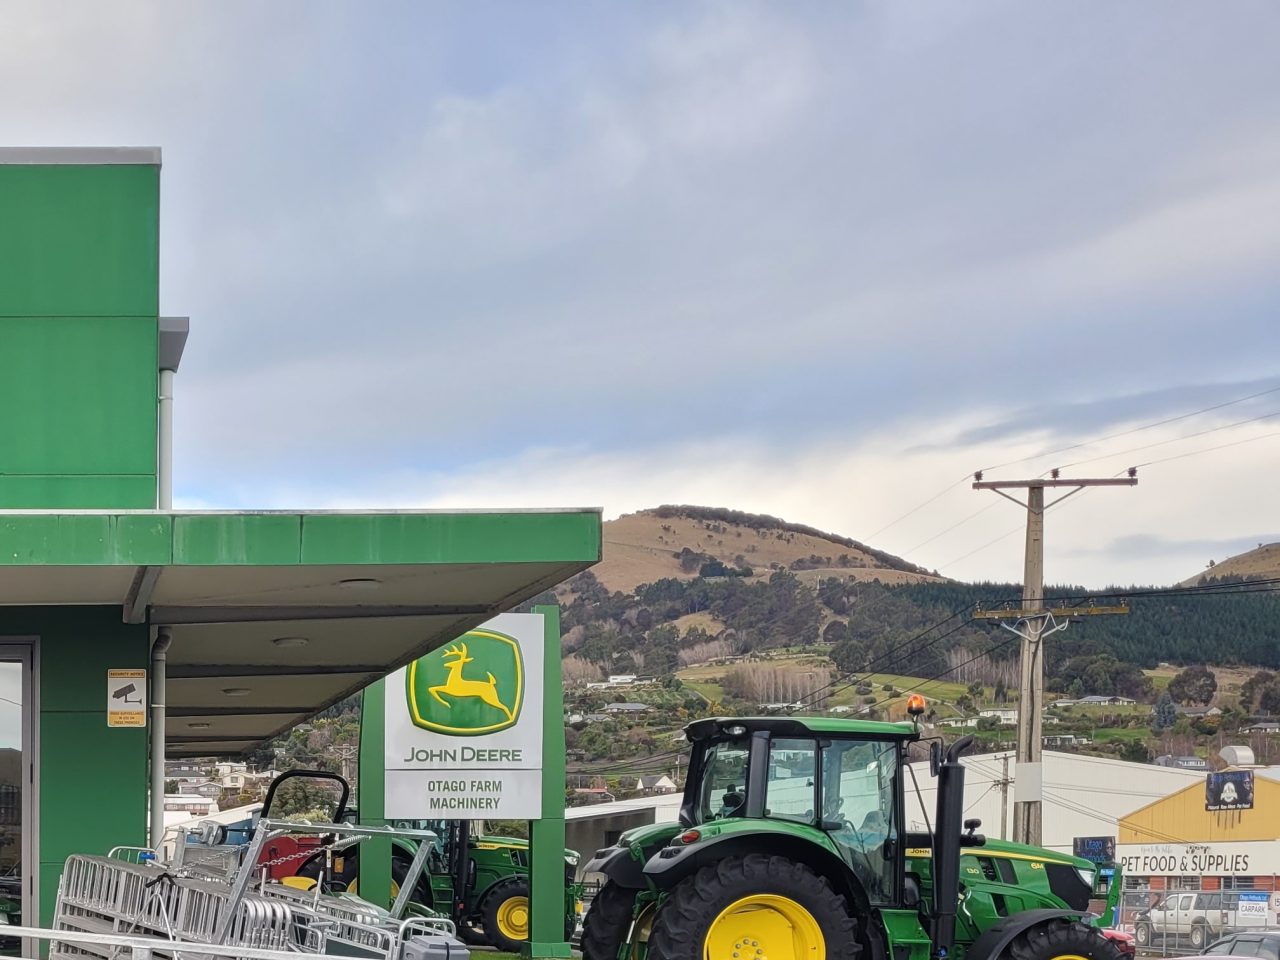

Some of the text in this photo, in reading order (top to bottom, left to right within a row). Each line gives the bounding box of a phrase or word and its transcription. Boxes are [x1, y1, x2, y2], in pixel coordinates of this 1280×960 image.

[404, 747, 522, 762] JOHN DEERE
[428, 781, 502, 792] OTAGO FARM
[430, 798, 500, 809] MACHINERY
[1121, 854, 1249, 872] PET FOOD & SUPPLIES
